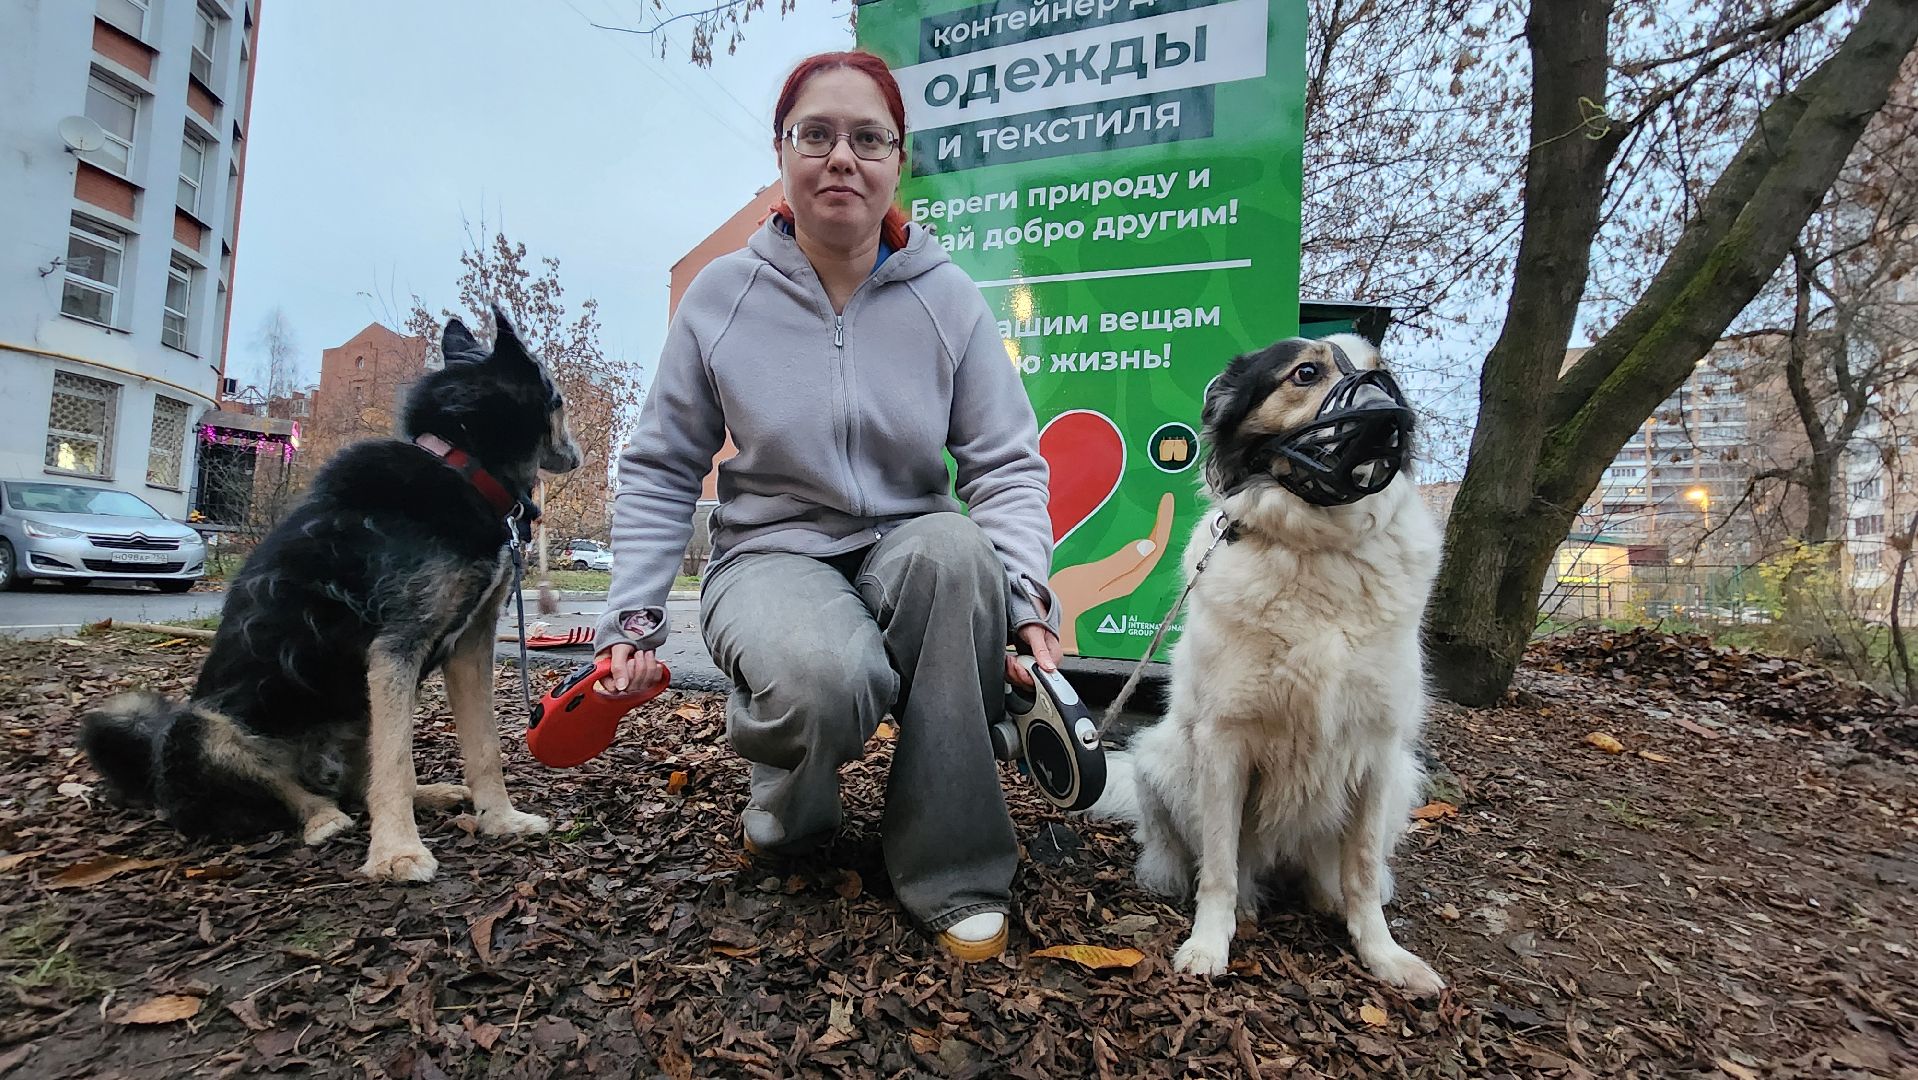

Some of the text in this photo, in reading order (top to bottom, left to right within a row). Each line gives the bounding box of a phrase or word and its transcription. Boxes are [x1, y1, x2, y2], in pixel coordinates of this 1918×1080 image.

[934, 0, 1119, 47] контейнер
[924, 24, 1208, 109] одежды
[938, 101, 1182, 160] и текстиля
[911, 168, 1211, 222] Береги природу и
[933, 199, 1239, 251] ай добро другим!
[996, 306, 1221, 339] ашим вещам
[1050, 343, 1172, 373] жизнь!
